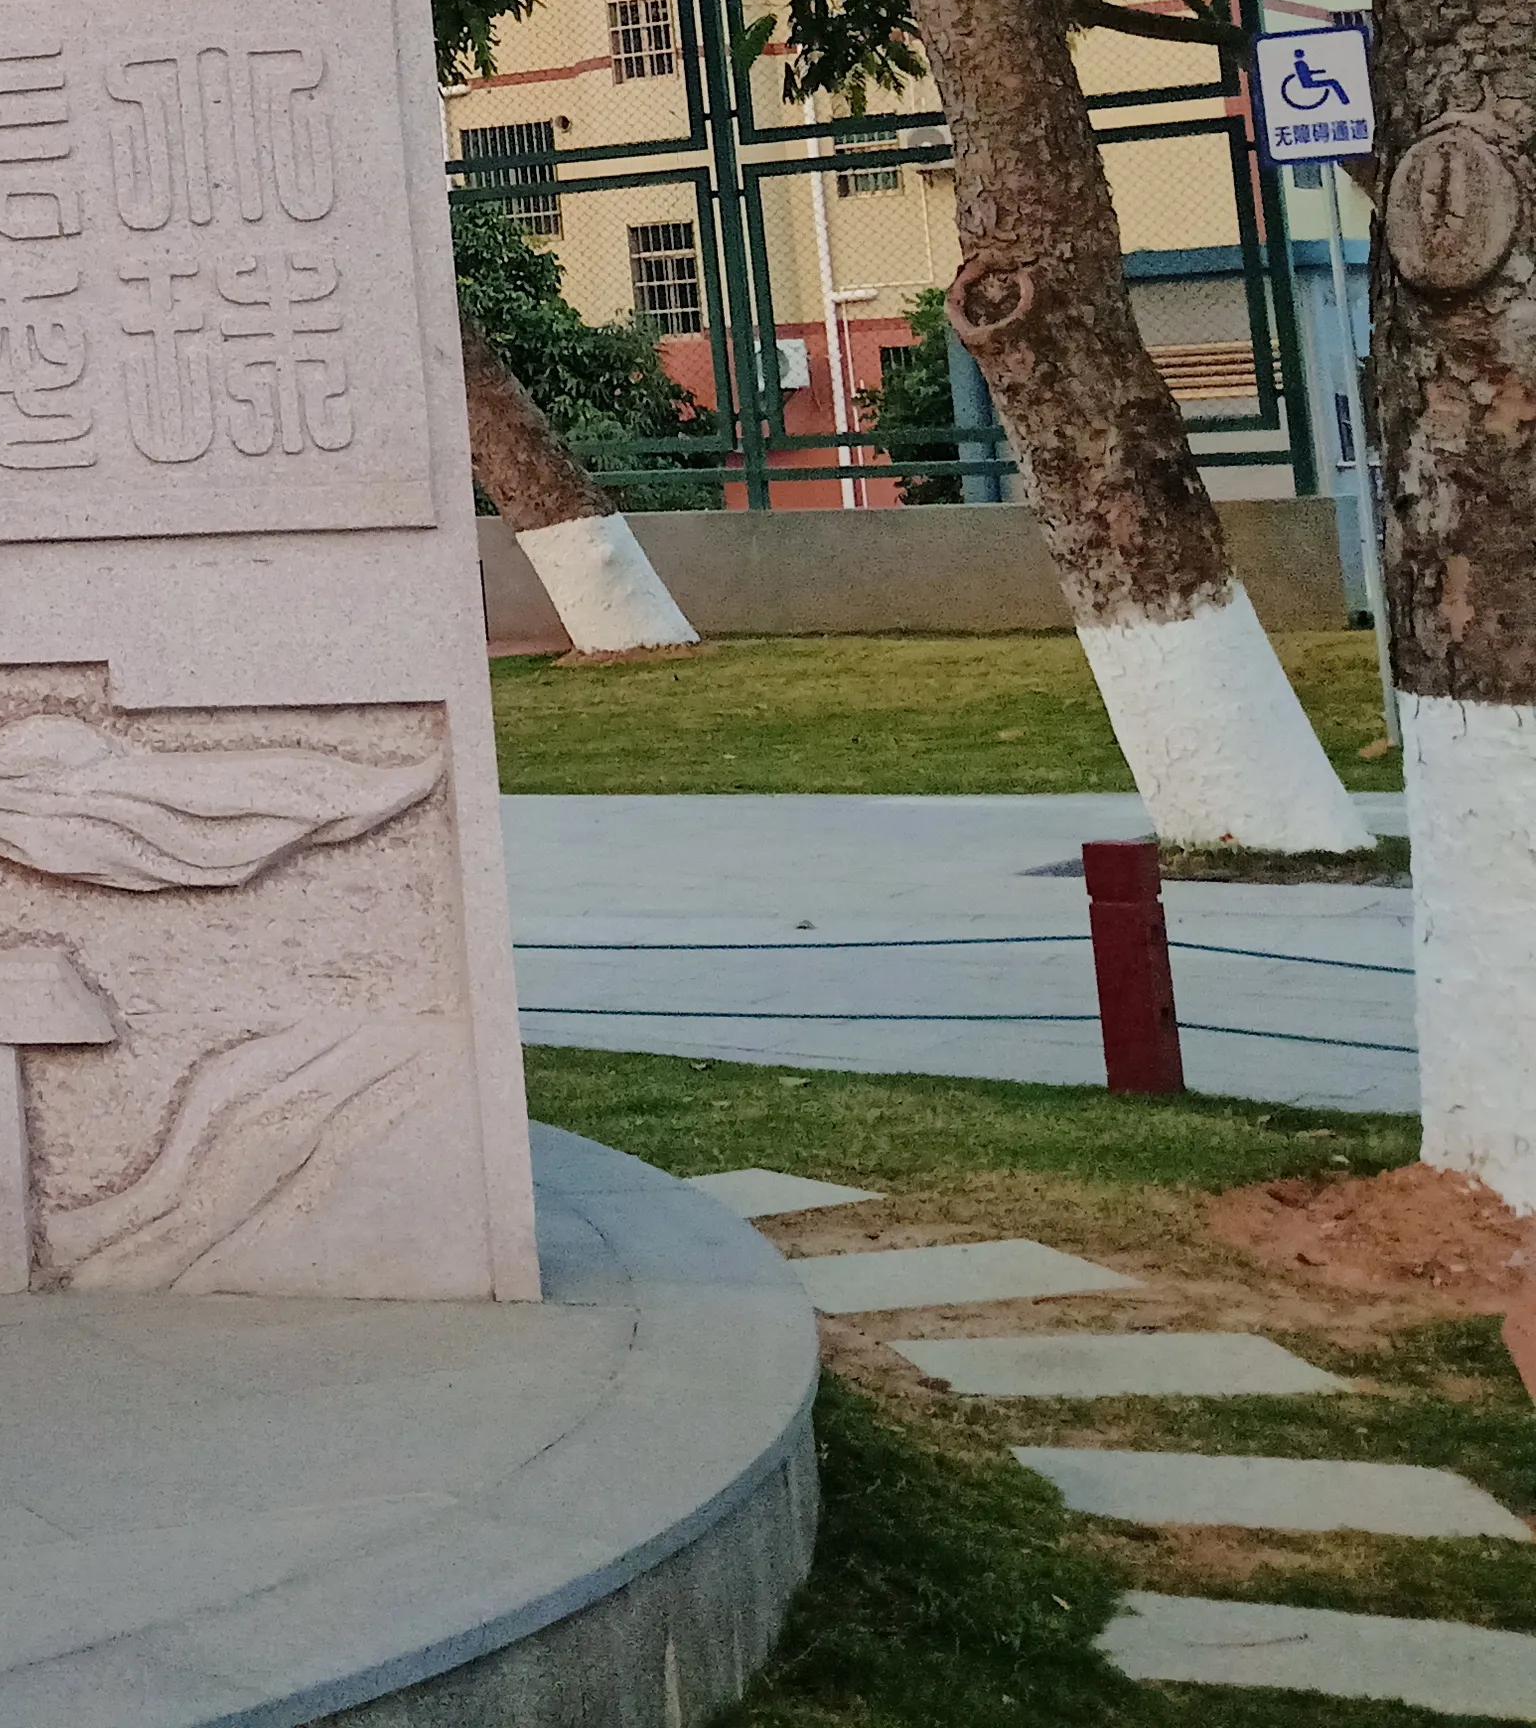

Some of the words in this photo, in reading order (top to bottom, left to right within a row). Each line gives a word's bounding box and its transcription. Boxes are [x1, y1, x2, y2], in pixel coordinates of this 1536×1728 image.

[1274, 119, 1368, 146] 无障碍通道
